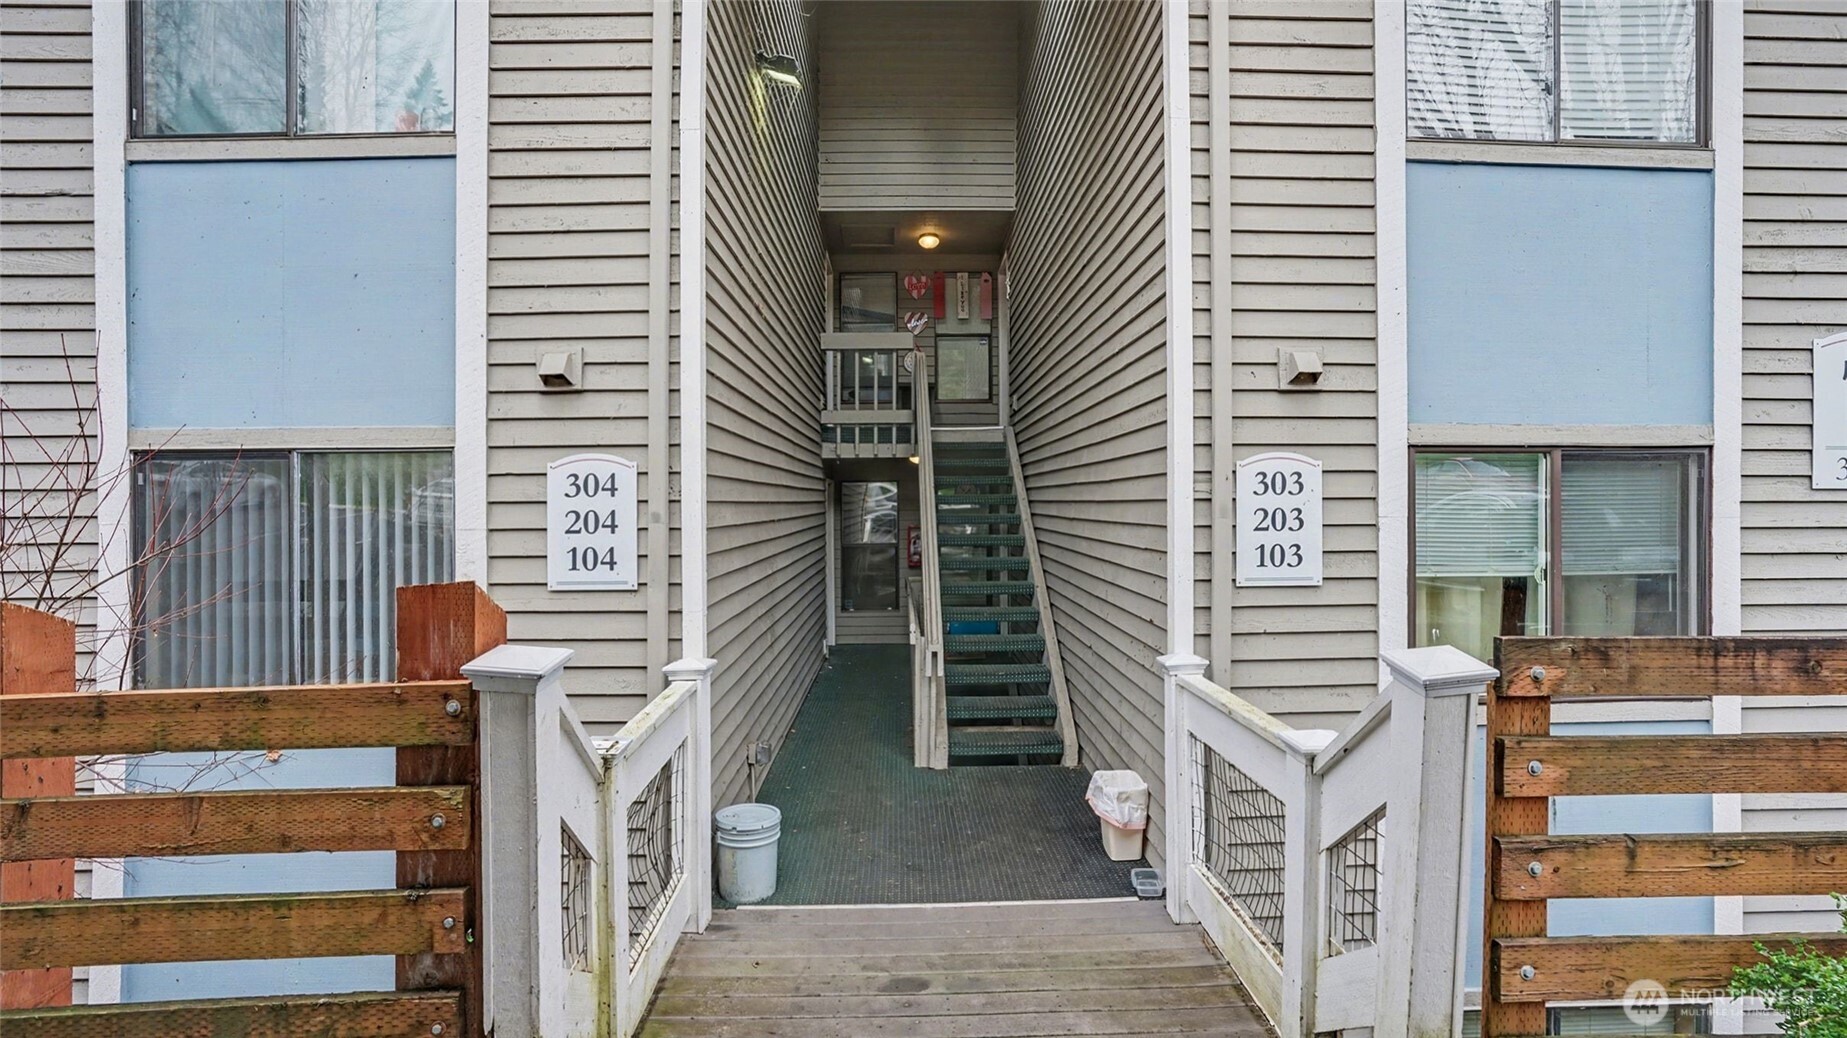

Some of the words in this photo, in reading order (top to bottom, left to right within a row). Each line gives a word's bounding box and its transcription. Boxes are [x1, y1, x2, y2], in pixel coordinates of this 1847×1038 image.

[564, 472, 618, 498] 304
[1252, 471, 1304, 496] 303
[564, 509, 619, 535] 204
[1252, 507, 1305, 532] 203
[566, 546, 617, 572] 104
[1255, 543, 1304, 568] 103
